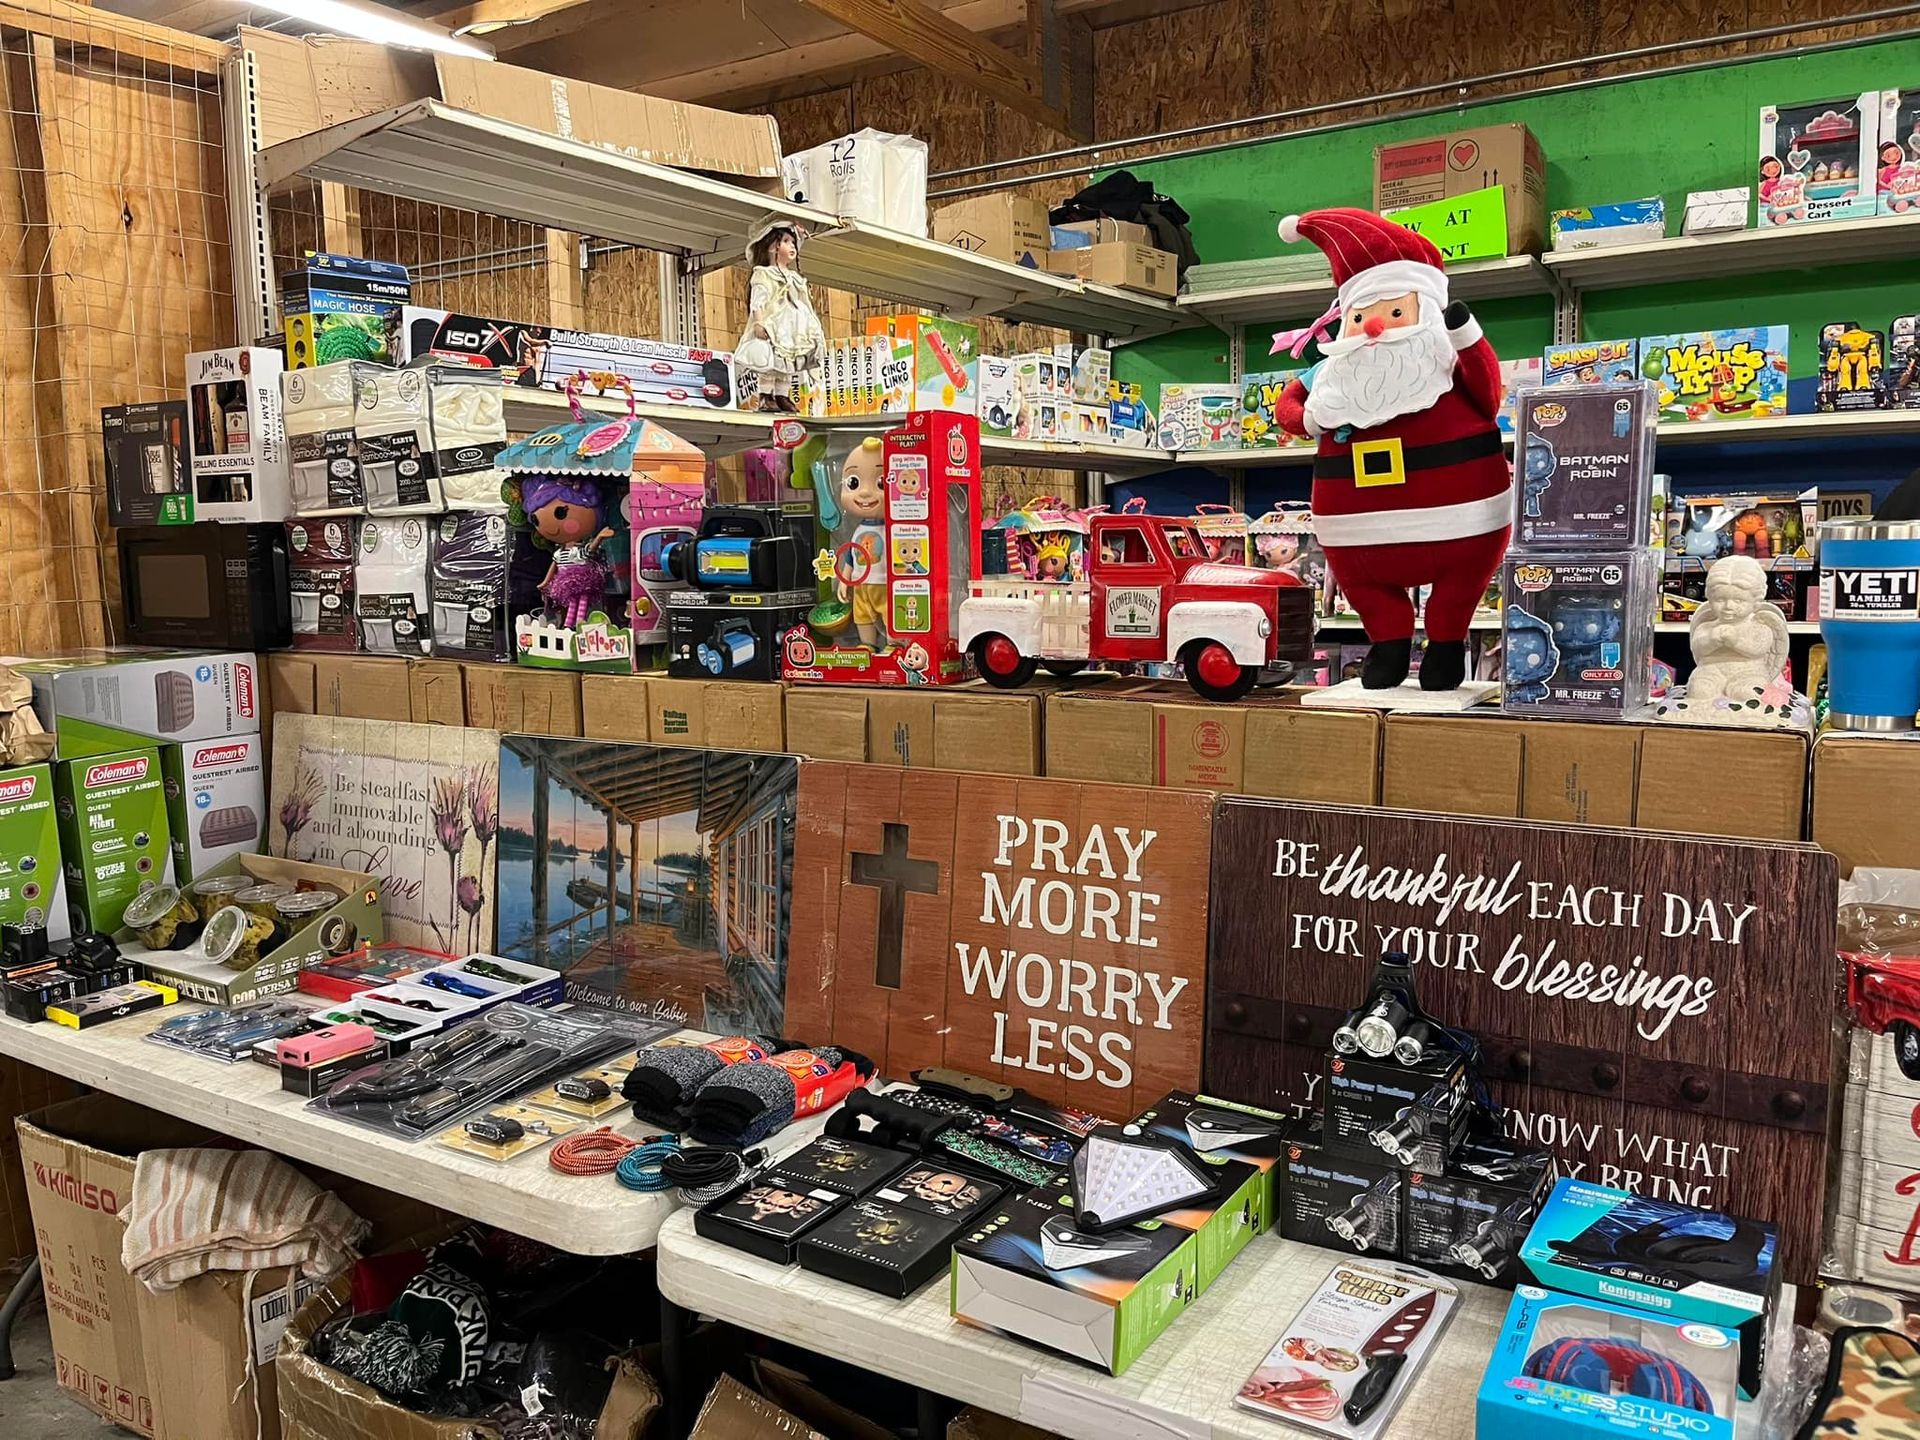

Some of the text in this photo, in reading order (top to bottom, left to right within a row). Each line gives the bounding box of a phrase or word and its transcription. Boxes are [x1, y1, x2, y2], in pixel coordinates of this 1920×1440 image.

[829, 138, 856, 163] 12
[829, 163, 855, 177] Rolls
[1807, 200, 1852, 210] Dessert
[1807, 211, 1832, 219] Cart
[1404, 209, 1471, 233] W AT
[1441, 243, 1469, 258] NT
[366, 283, 408, 296] 15m/50ft
[313, 299, 344, 311] MAGIC
[348, 303, 376, 314] HOSE
[550, 330, 713, 362] Build Strength & Lean Muscle FAST!
[200, 353, 235, 380] JIM BEAM
[1549, 344, 1630, 369] SPLASH OUT
[1667, 342, 1765, 374] Mouse
[882, 361, 907, 377] CINCO
[790, 375, 800, 404] LINKO
[884, 372, 909, 389] LINKO
[1535, 405, 1565, 420] POP!
[1617, 402, 1629, 411] 65
[258, 388, 272, 463] BEAM FAMILY
[194, 457, 255, 469] GRILLING ESSENTIALS
[460, 451, 478, 459] QUEEN
[1560, 454, 1629, 466] BATMAN
[1570, 468, 1617, 481] ROBIN
[1822, 500, 1863, 520] TOYS
[329, 525, 336, 536] 6
[408, 524, 415, 535] 6
[492, 518, 499, 530] 6
[1516, 565, 1552, 583] POP!
[1562, 575, 1593, 583] ROBIN
[1603, 570, 1620, 580] 65
[1838, 571, 1916, 594] YETI
[435, 591, 463, 601] Bamboo
[1109, 591, 1157, 616] FLOWER MARKET
[223, 662, 231, 703] GUESTREST
[237, 666, 250, 707] Coleman
[1555, 690, 1603, 700] MR. FREEZE
[196, 749, 239, 764] Coleman
[90, 764, 136, 783] Coleman
[192, 765, 260, 781] GUESTREST AIRBED
[85, 780, 161, 800] GUESTREST AIRBED
[193, 784, 214, 792] QUEEN
[335, 773, 431, 802] Be steadfast
[20, 801, 50, 813] AIRBED
[87, 803, 112, 812] QUEEN
[333, 797, 423, 825] immovable
[313, 820, 437, 856] and abounding
[993, 815, 1157, 881] PRAY
[320, 842, 335, 860] in
[1272, 838, 1758, 945] BE thankful EACH DAY
[979, 872, 1161, 948] MORE
[955, 942, 1189, 1030] WORRY
[1291, 914, 1717, 1041] FOR YOUR blessings
[566, 982, 688, 1023] Welcome to our Cabin
[990, 1011, 1133, 1089] LESS
[1615, 1128, 1739, 1178] WHAT
[50, 1171, 117, 1215] KIMISO
[1335, 1270, 1410, 1298] Copper
[1336, 1281, 1392, 1305] Knife
[1598, 1280, 1672, 1309] Konigsaigg
[1618, 1399, 1710, 1433] STUDIO
